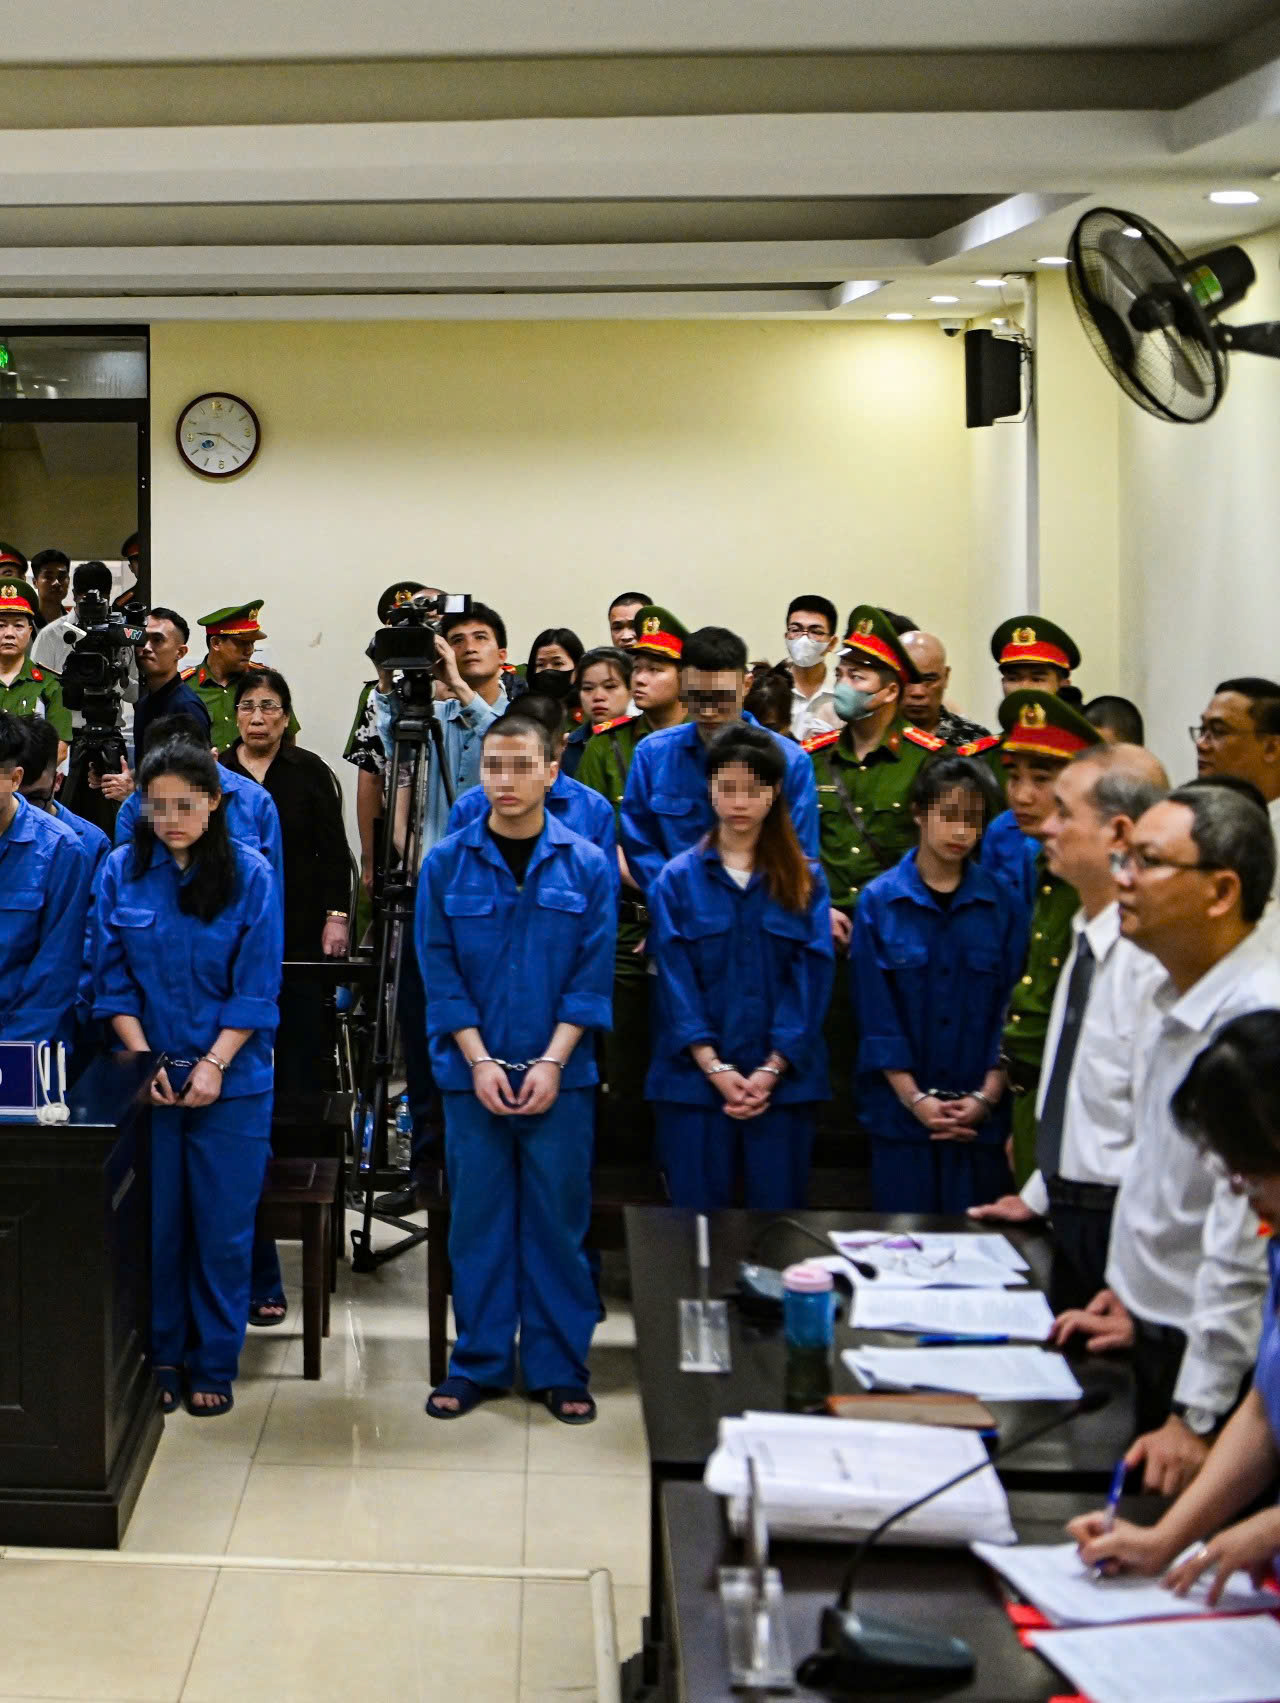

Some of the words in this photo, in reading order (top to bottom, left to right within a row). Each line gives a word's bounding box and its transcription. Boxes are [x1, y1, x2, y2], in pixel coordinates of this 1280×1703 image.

[211, 401, 222, 411] 12
[186, 433, 194, 443] 9
[218, 460, 225, 470] 6
[123, 627, 143, 640] VTV
